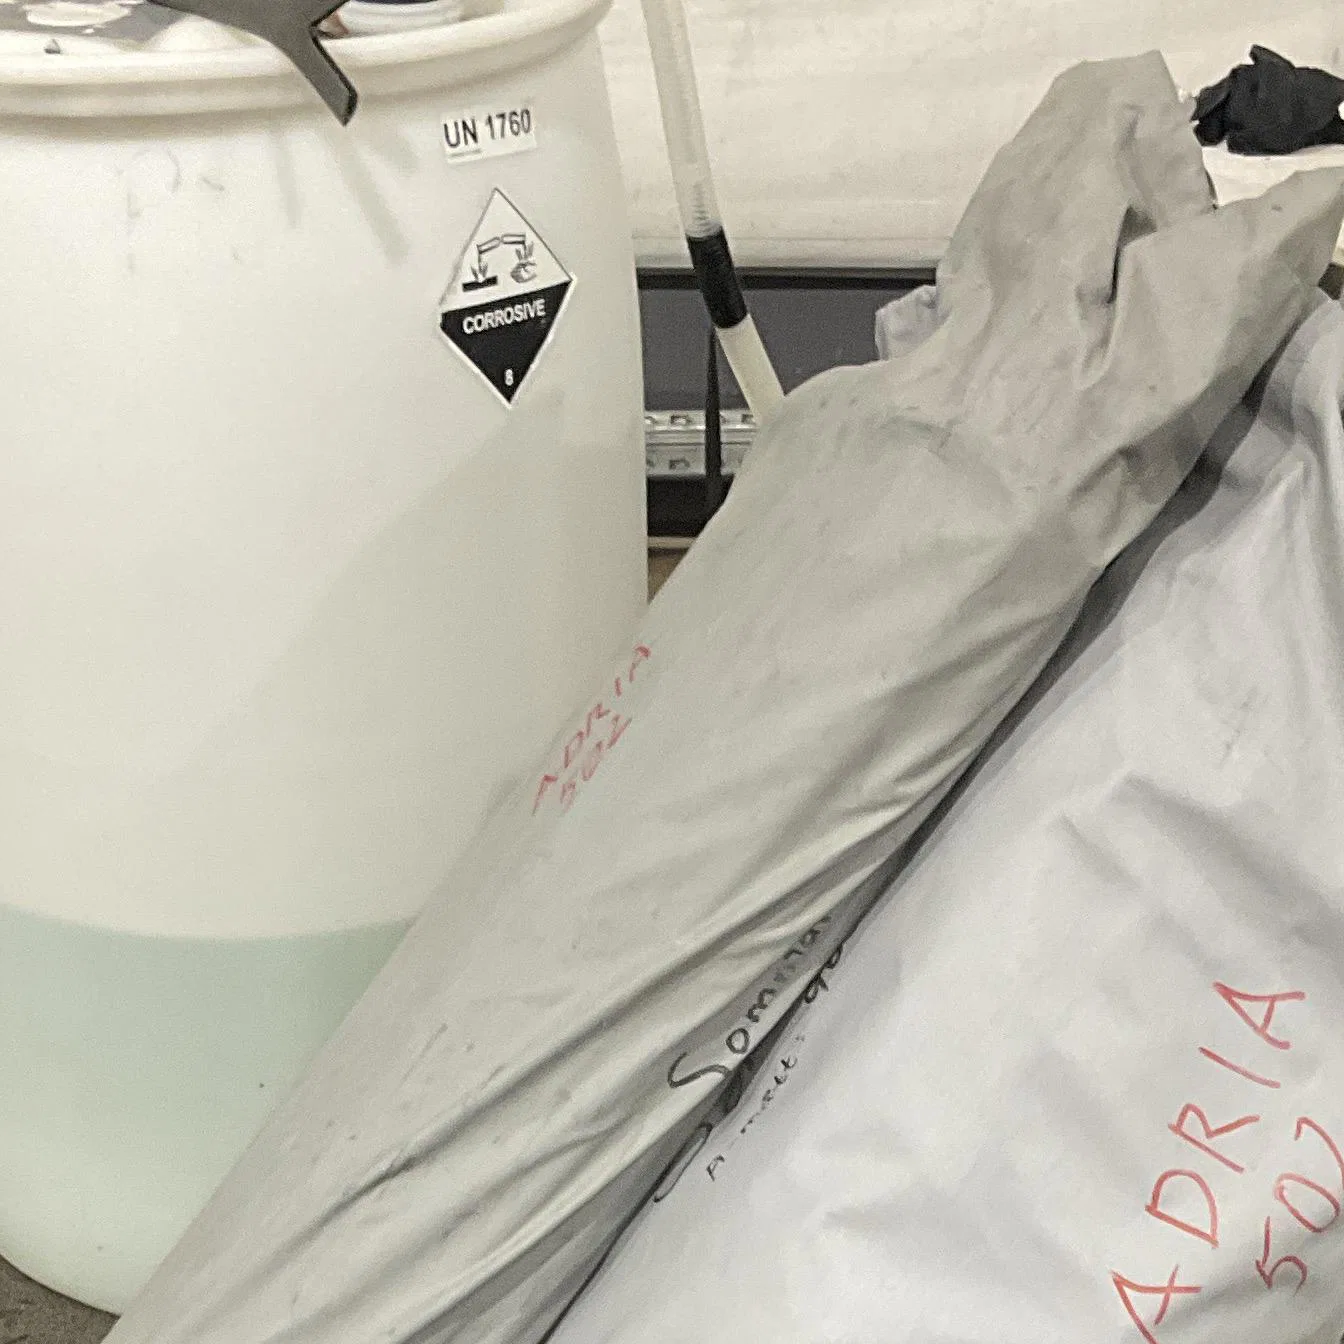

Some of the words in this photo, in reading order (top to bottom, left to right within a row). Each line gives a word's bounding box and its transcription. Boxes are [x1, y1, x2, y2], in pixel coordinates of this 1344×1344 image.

[443, 117, 479, 148] UN
[485, 108, 532, 140] 1760
[461, 298, 547, 334] CORROSIVE
[504, 368, 514, 387] 8
[531, 643, 652, 816] ADRIA
